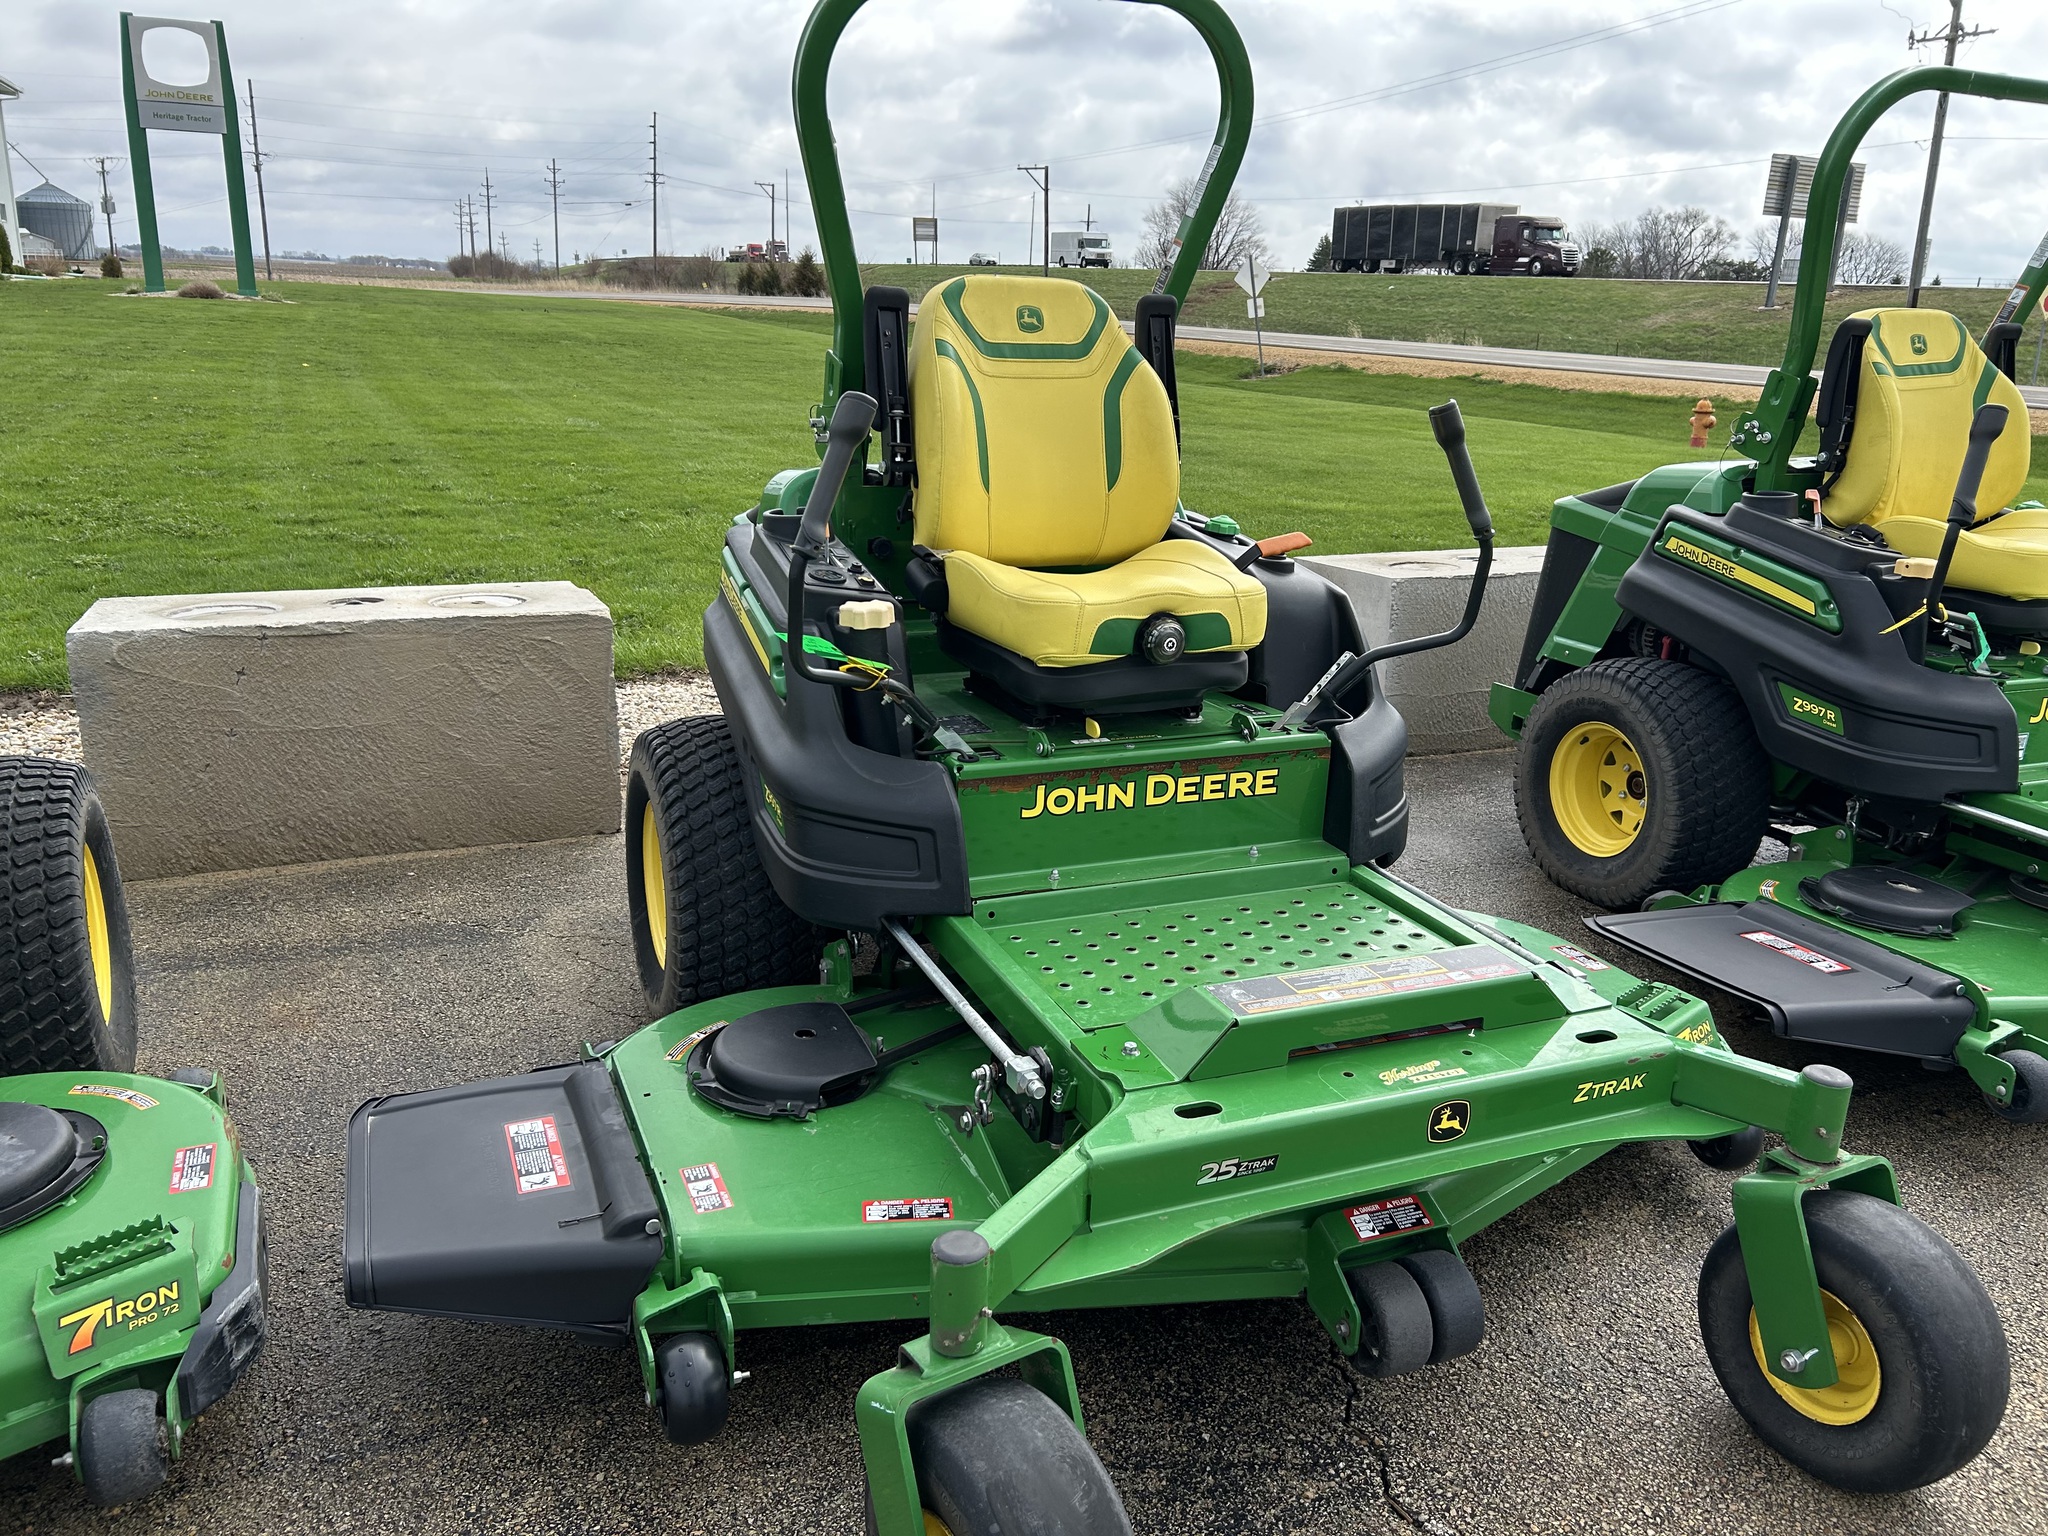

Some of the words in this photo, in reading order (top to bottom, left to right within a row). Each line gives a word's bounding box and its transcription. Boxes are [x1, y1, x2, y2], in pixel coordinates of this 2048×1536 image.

[145, 89, 175, 99] JOHN
[176, 91, 214, 102] DEERE
[152, 111, 184, 121] Heritage
[186, 113, 212, 123] Tractor
[1671, 541, 1700, 565] JOHN
[1700, 551, 1736, 579] DEERE
[1020, 781, 1136, 820] JOHN
[1144, 768, 1280, 808] DEERE
[1572, 1071, 1650, 1106] ZTRAK
[1196, 1157, 1240, 1186] 25
[1238, 1157, 1276, 1172] ZTRAK
[1358, 1204, 1381, 1214] DANGER
[1391, 1197, 1414, 1207] PELIGRO
[128, 1312, 159, 1332] PRO
[161, 1303, 180, 1319] 72
